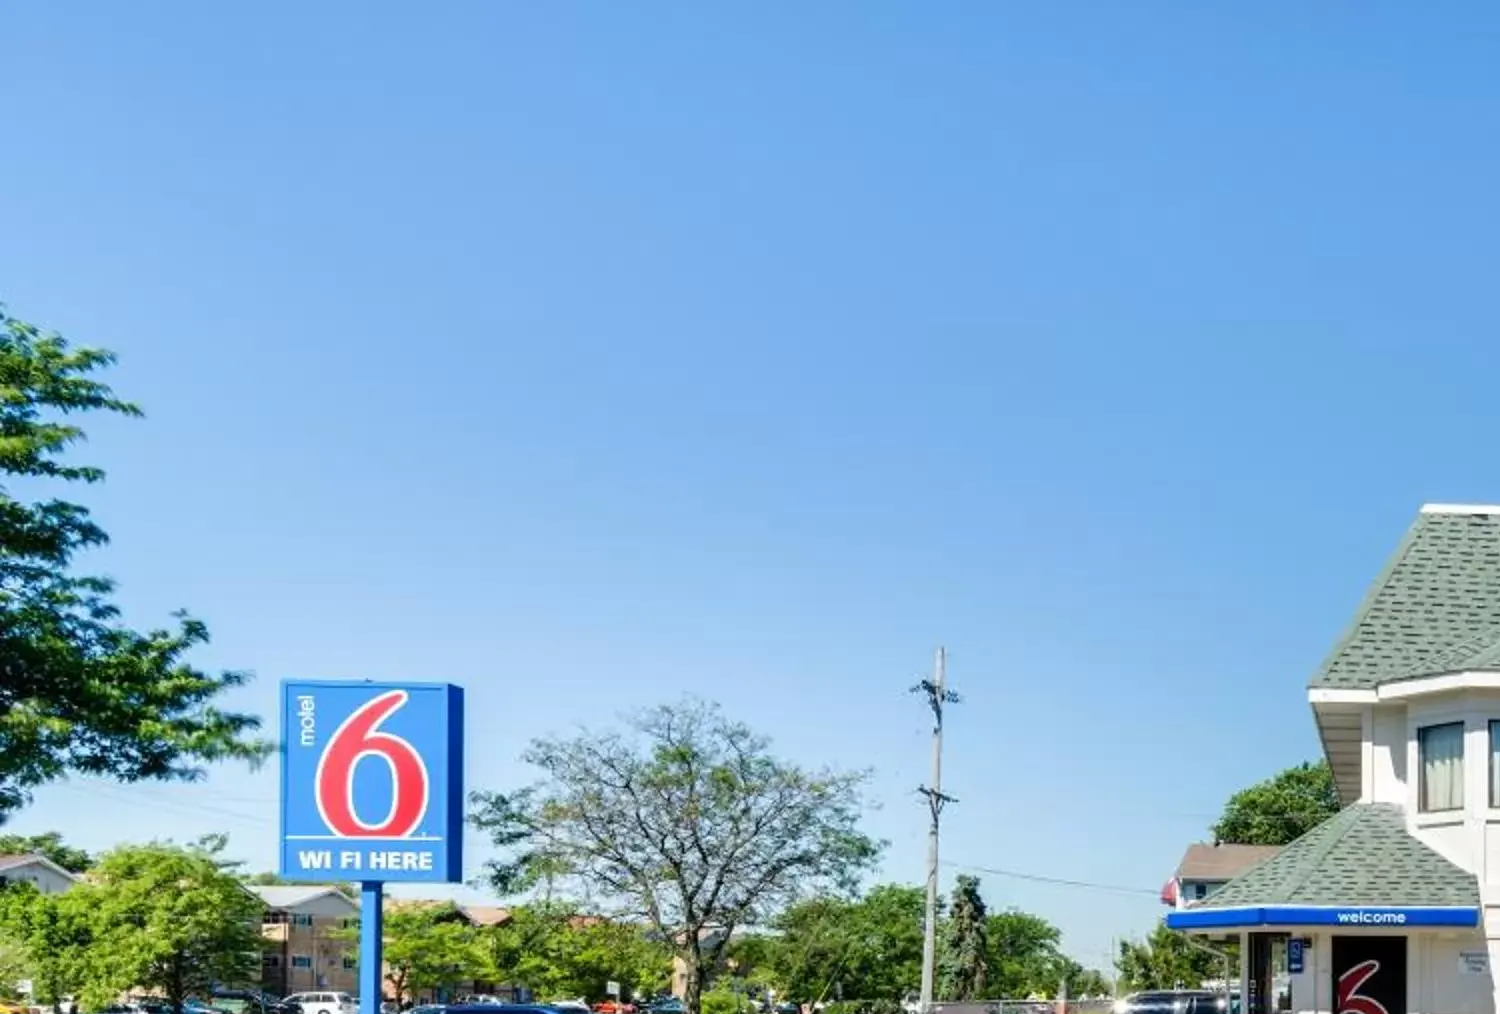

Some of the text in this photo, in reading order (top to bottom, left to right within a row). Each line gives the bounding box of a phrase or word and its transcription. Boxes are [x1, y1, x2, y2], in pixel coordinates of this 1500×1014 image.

[296, 695, 315, 746] motel
[314, 689, 429, 838] 6
[298, 851, 433, 870] WI FI HERE
[1337, 909, 1406, 923] welcome
